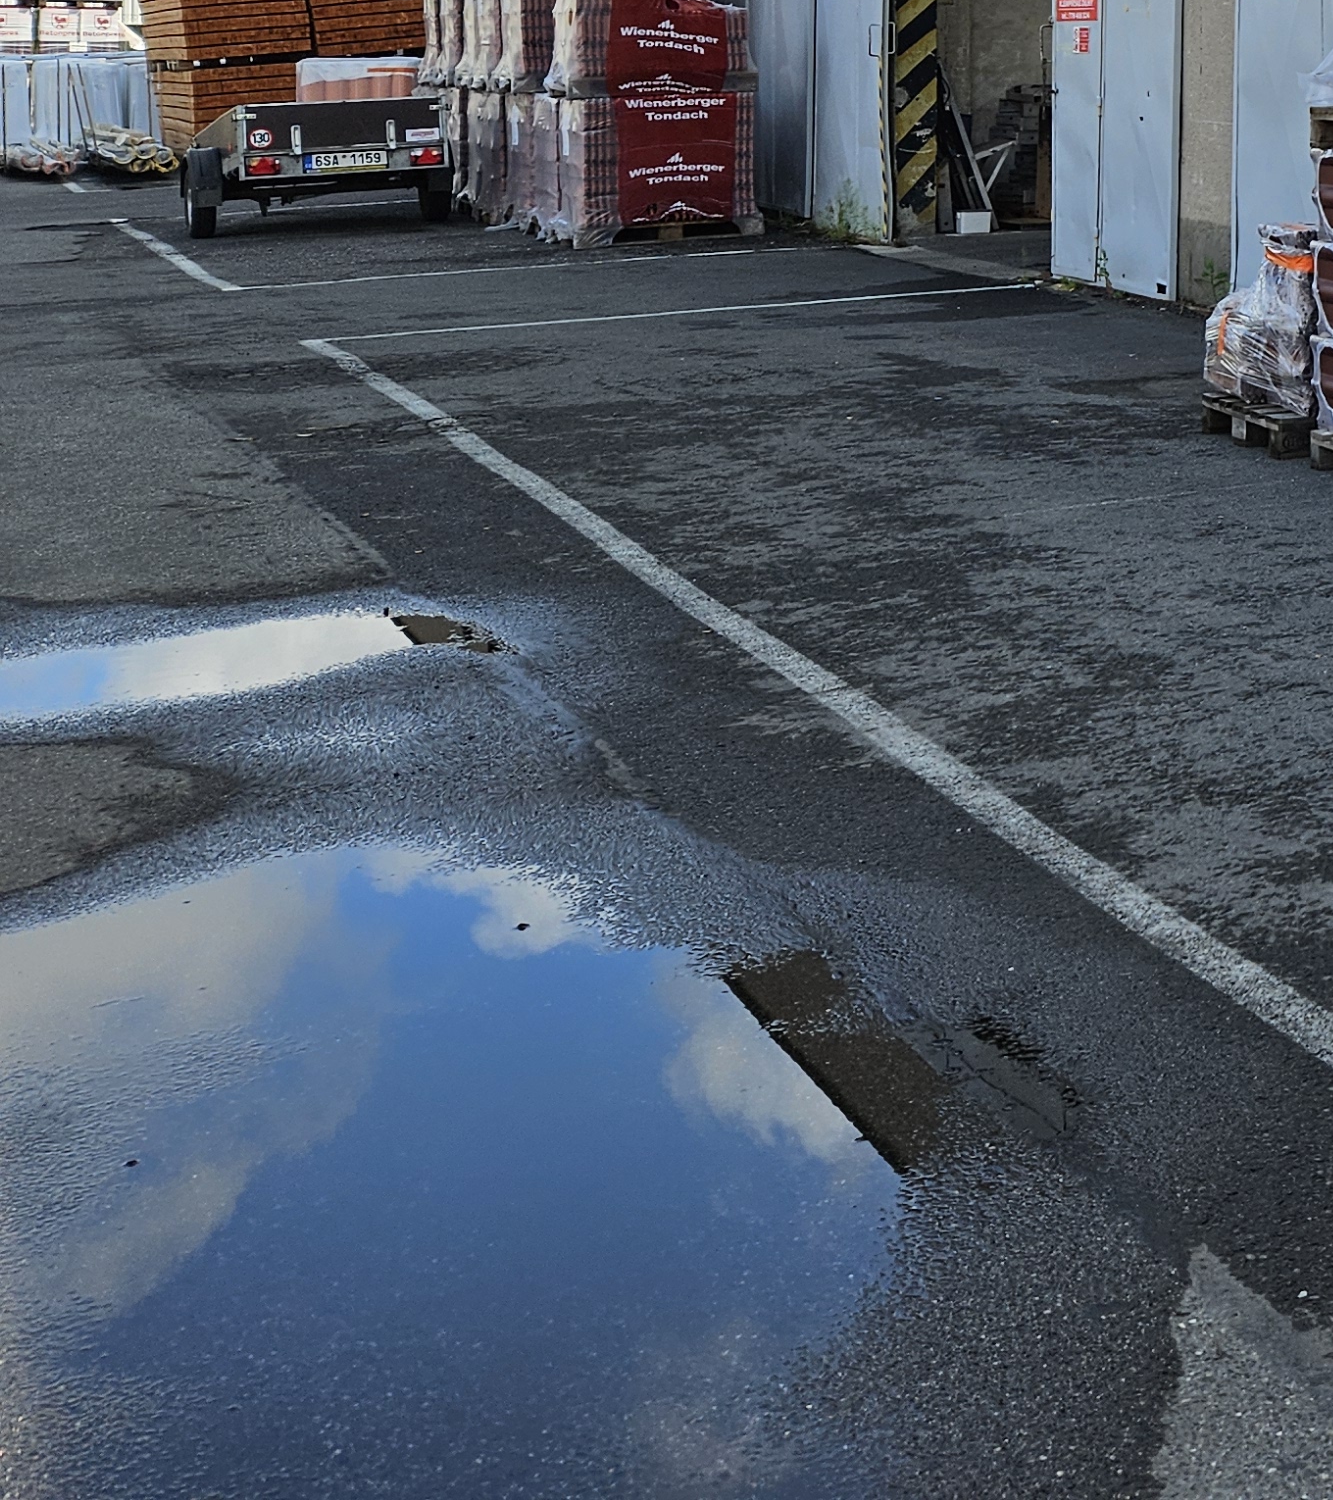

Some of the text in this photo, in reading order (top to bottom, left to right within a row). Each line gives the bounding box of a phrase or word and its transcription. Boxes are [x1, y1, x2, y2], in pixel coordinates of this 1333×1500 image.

[620, 26, 719, 45] Wienerberger
[637, 39, 705, 55] Tondach
[625, 98, 727, 109] Wienerberger
[645, 109, 709, 121] Tondach
[252, 132, 270, 144] 130
[315, 151, 382, 167] 6SA 1159
[629, 164, 726, 178] Wienerberger
[646, 174, 709, 185] Tondach
